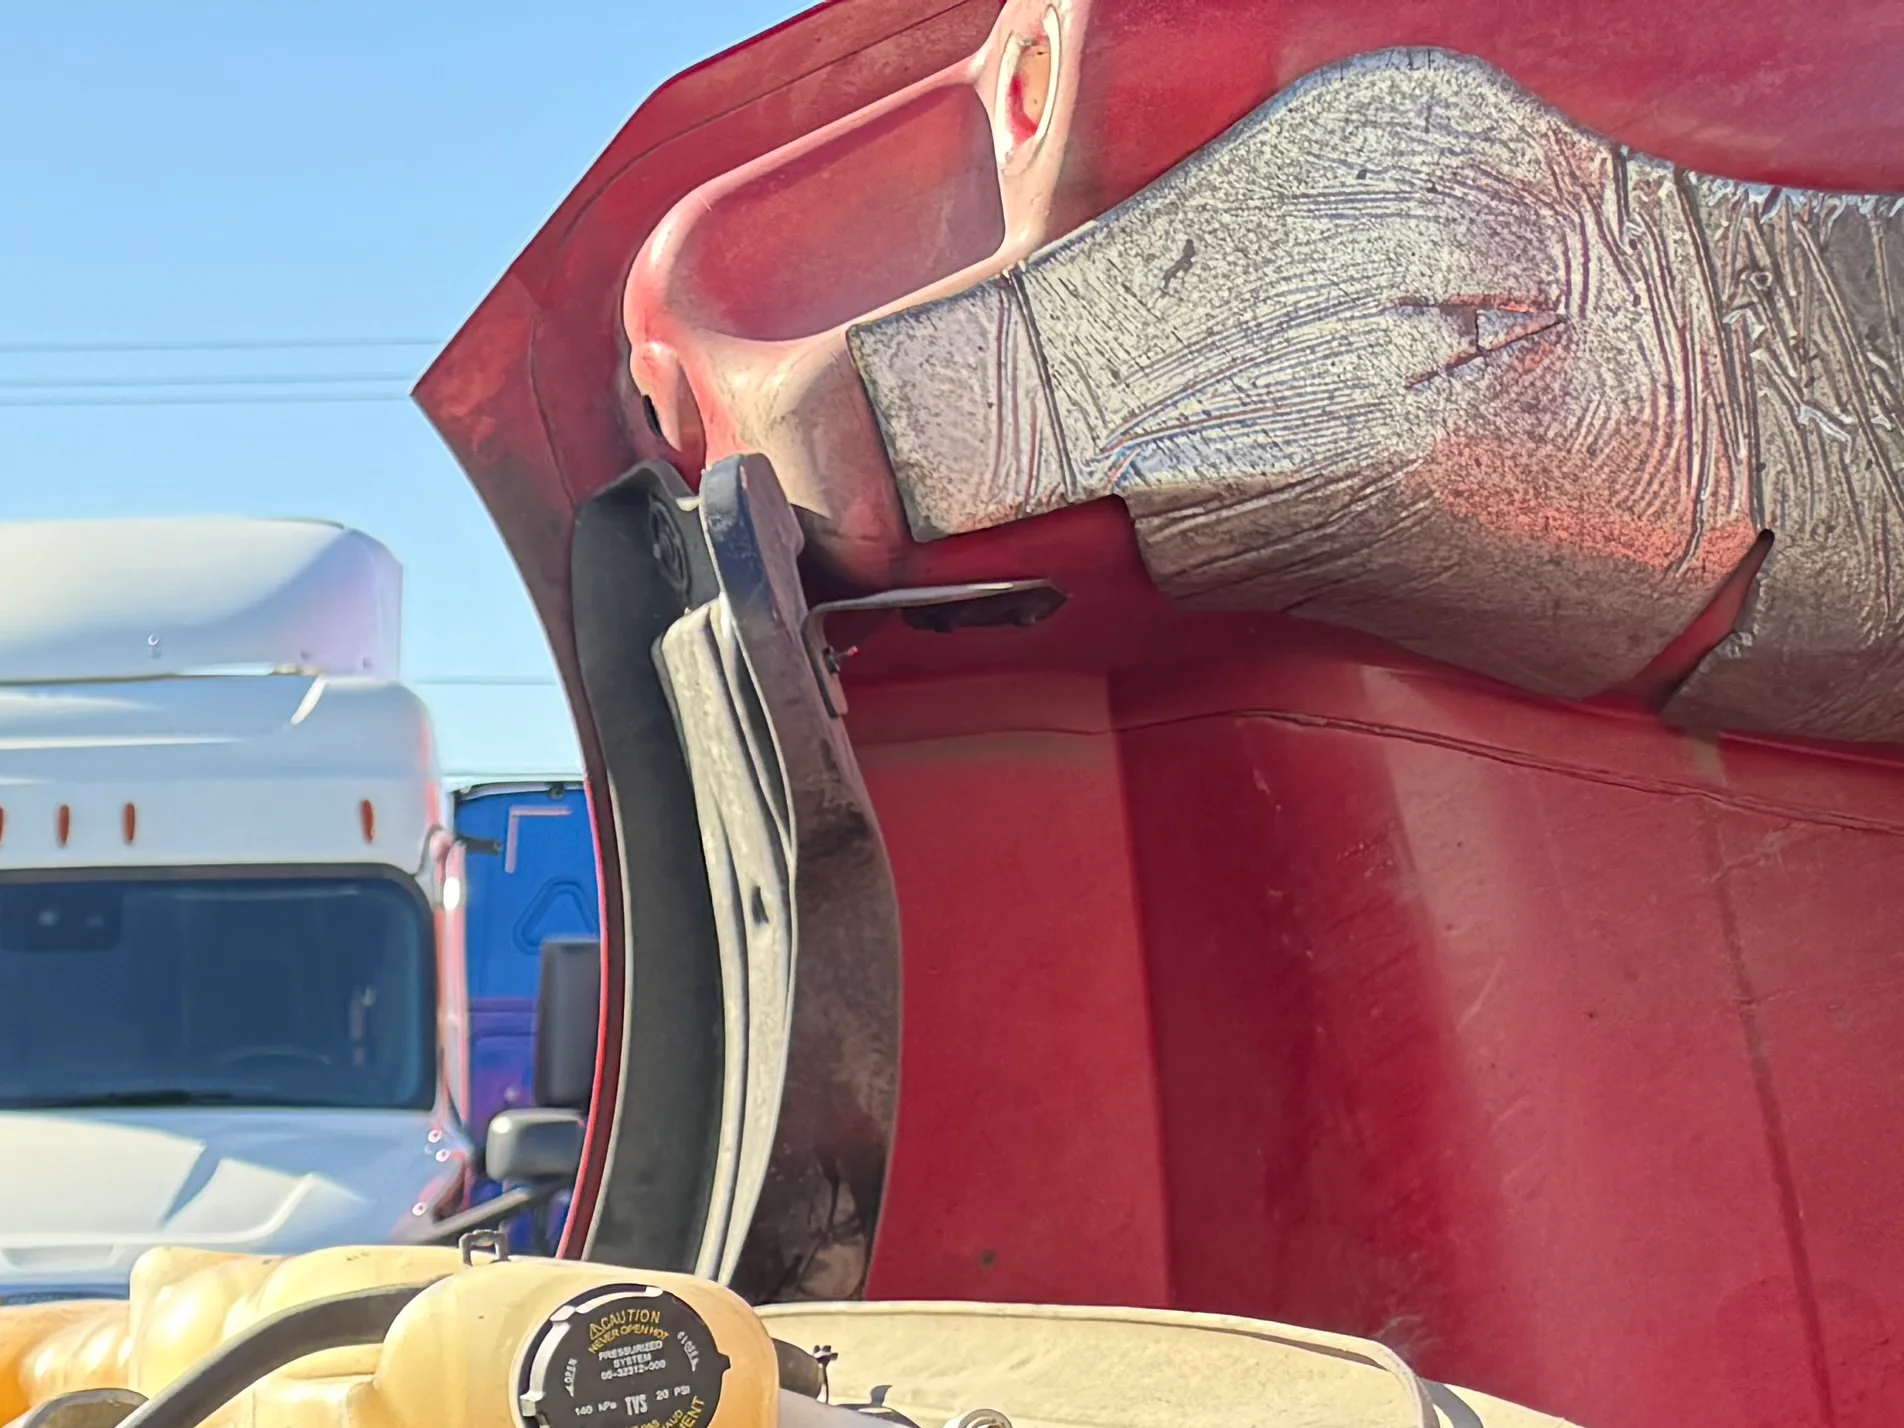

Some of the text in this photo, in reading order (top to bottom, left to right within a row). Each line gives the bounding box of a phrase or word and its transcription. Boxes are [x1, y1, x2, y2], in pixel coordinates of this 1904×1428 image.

[600, 1309, 660, 1330] CAUTION
[588, 1324, 669, 1353] NEVER OPEN HOT
[598, 1340, 663, 1360] PRESSURIZED
[613, 1353, 652, 1368] SYSTEM
[674, 1385, 690, 1396] PSI
[624, 1394, 648, 1416] TVS
